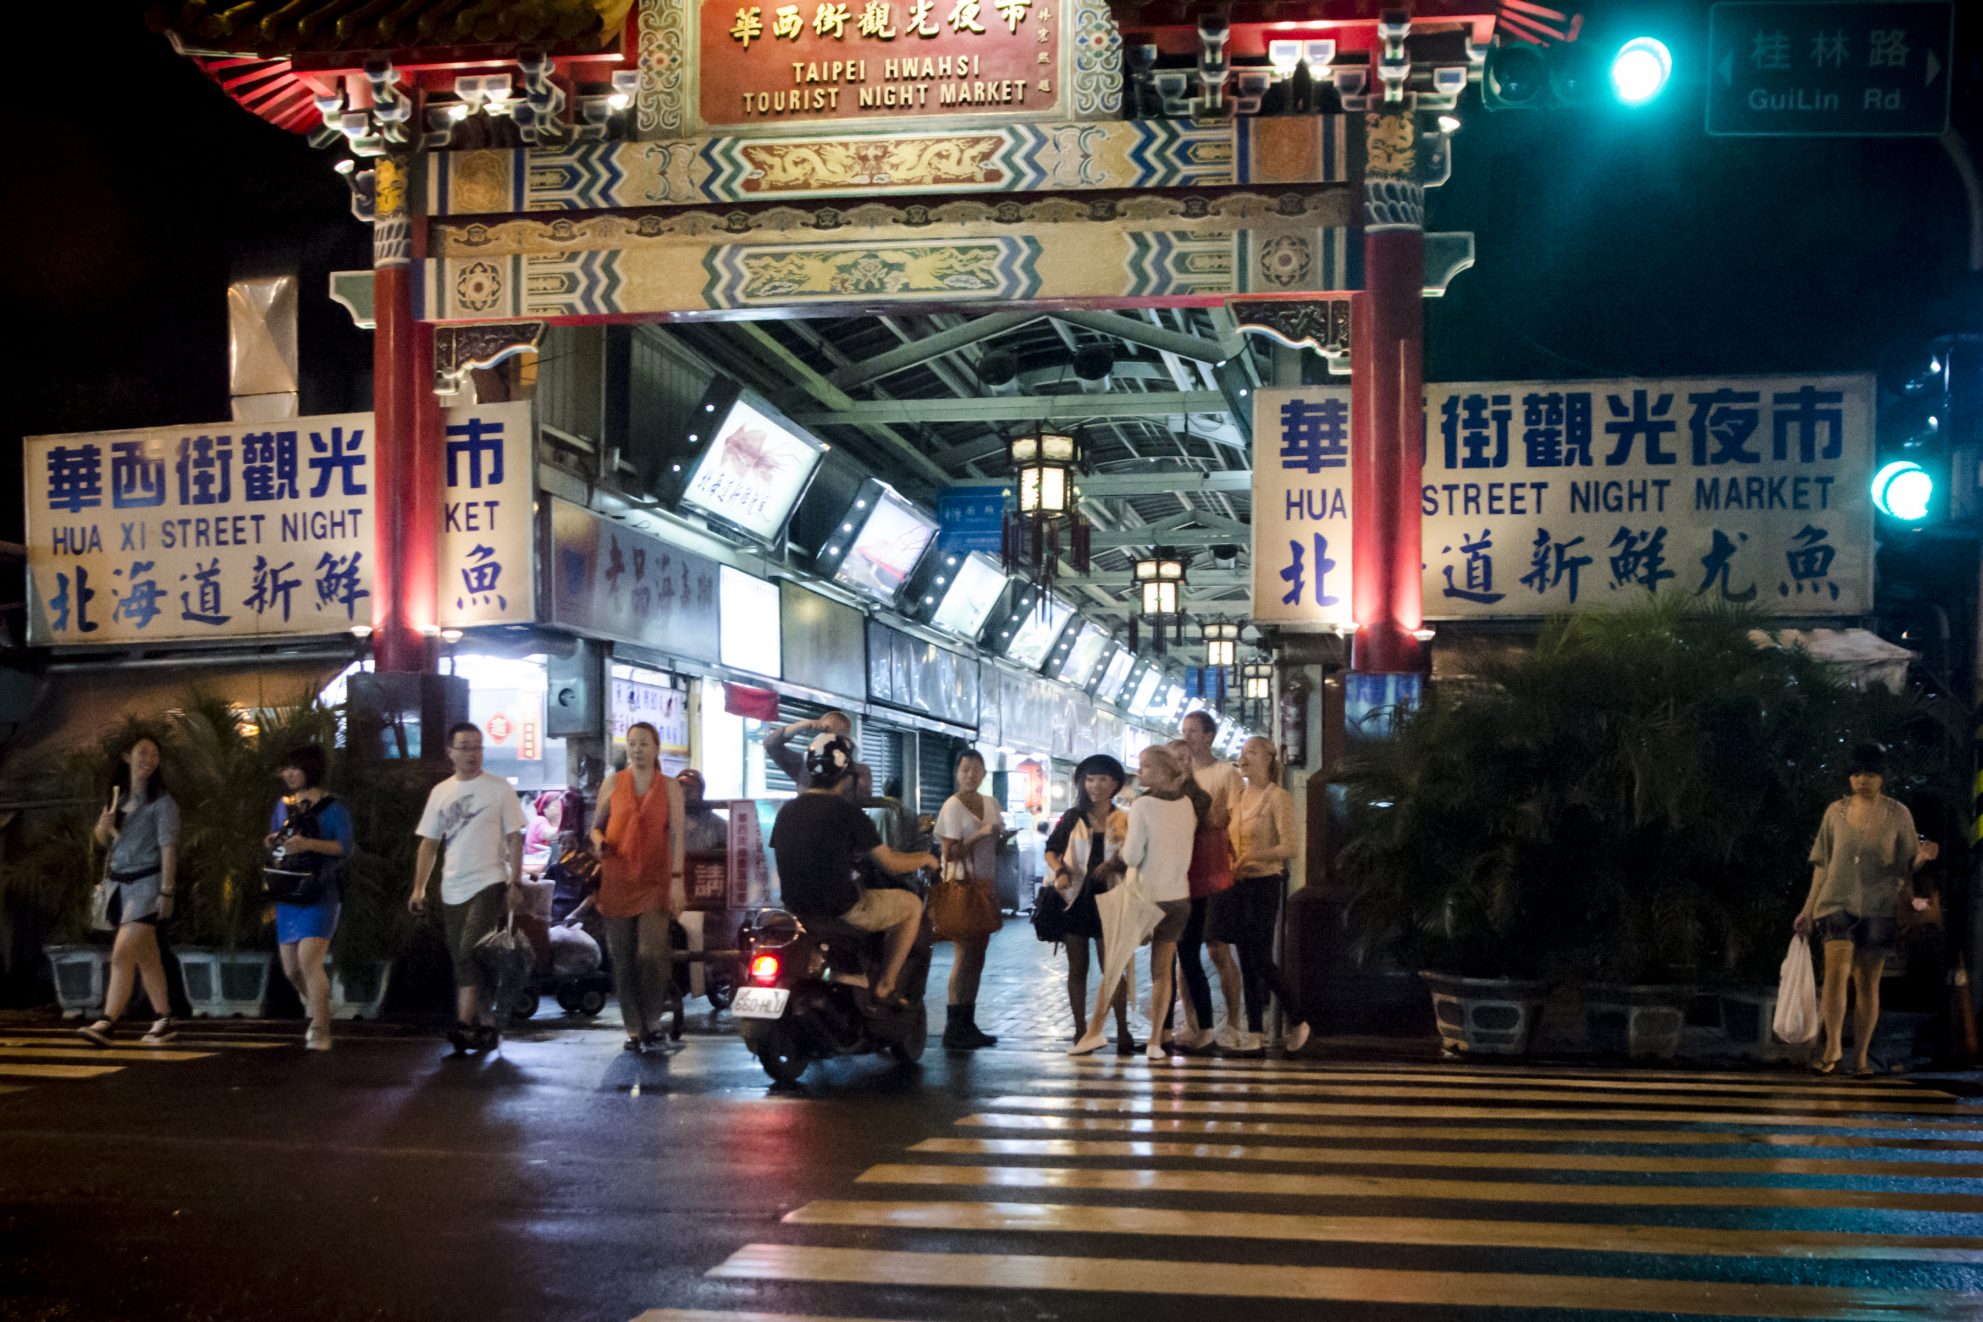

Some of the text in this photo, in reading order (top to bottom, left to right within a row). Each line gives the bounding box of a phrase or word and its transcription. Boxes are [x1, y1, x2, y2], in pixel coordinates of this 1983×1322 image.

[729, 0, 1032, 48] 華西街觀光夜市
[792, 55, 980, 83] TAIPEI HWAHSI
[1751, 29, 1910, 69] 桂林路
[743, 79, 1027, 113] TOURIST NIGHT MARKET
[1750, 88, 1839, 110] GuiLin
[1285, 476, 1834, 521] HUA STREET NIGHT MARKET
[53, 524, 103, 556] HUA
[121, 521, 146, 551] XI
[161, 514, 266, 549] STREET
[281, 508, 363, 543] NIGHT
